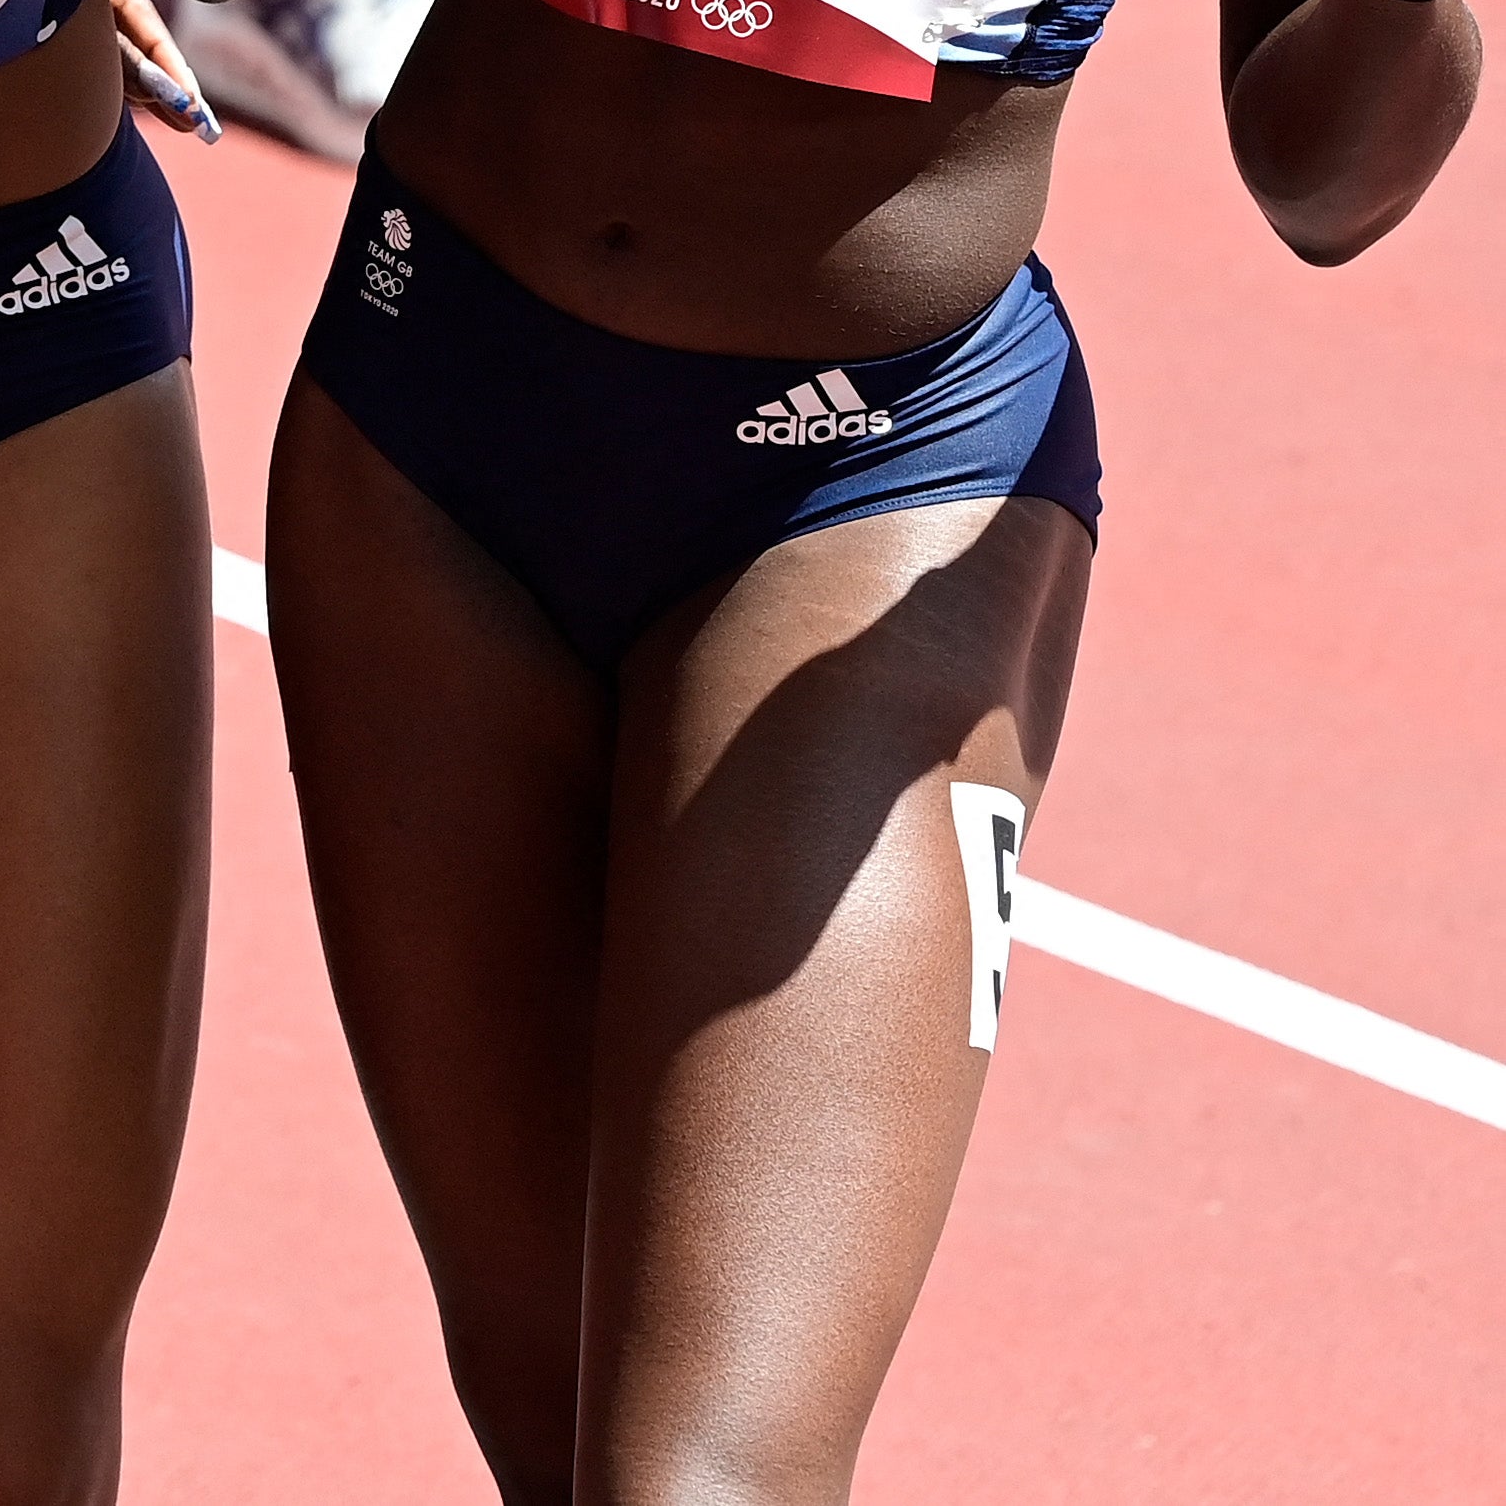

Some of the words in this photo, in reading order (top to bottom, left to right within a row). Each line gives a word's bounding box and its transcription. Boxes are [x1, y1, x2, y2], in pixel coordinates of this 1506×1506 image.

[367, 240, 396, 267] TEAM
[396, 261, 413, 278] GB
[360, 288, 382, 308] TOKYO
[381, 302, 399, 317] 2020
[736, 406, 894, 446] adidas
